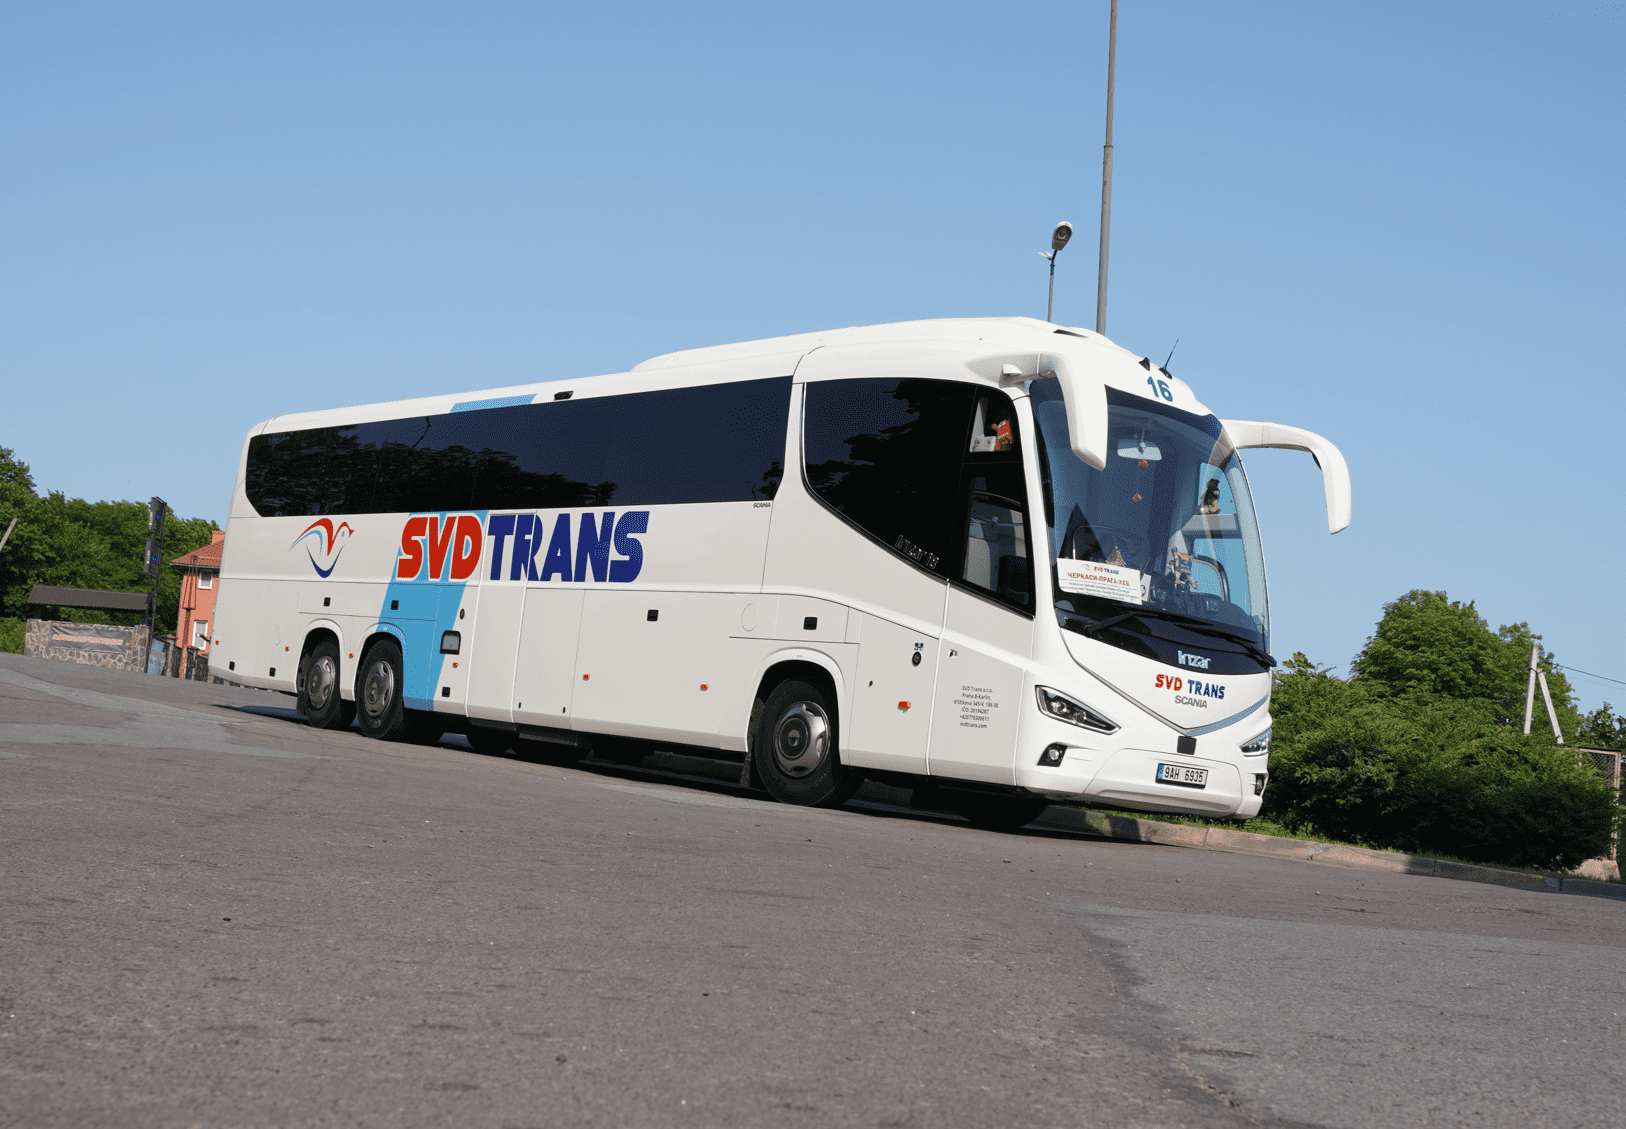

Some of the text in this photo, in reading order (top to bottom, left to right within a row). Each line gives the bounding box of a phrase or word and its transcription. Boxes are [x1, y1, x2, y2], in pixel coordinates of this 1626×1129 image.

[1146, 376, 1174, 402] 16
[396, 510, 651, 583] SVD TRANS
[1154, 673, 1226, 700] SVD TRANS
[1174, 695, 1208, 709] SCANIA
[1164, 766, 1180, 780] 9AH
[1184, 769, 1204, 783] 6935
